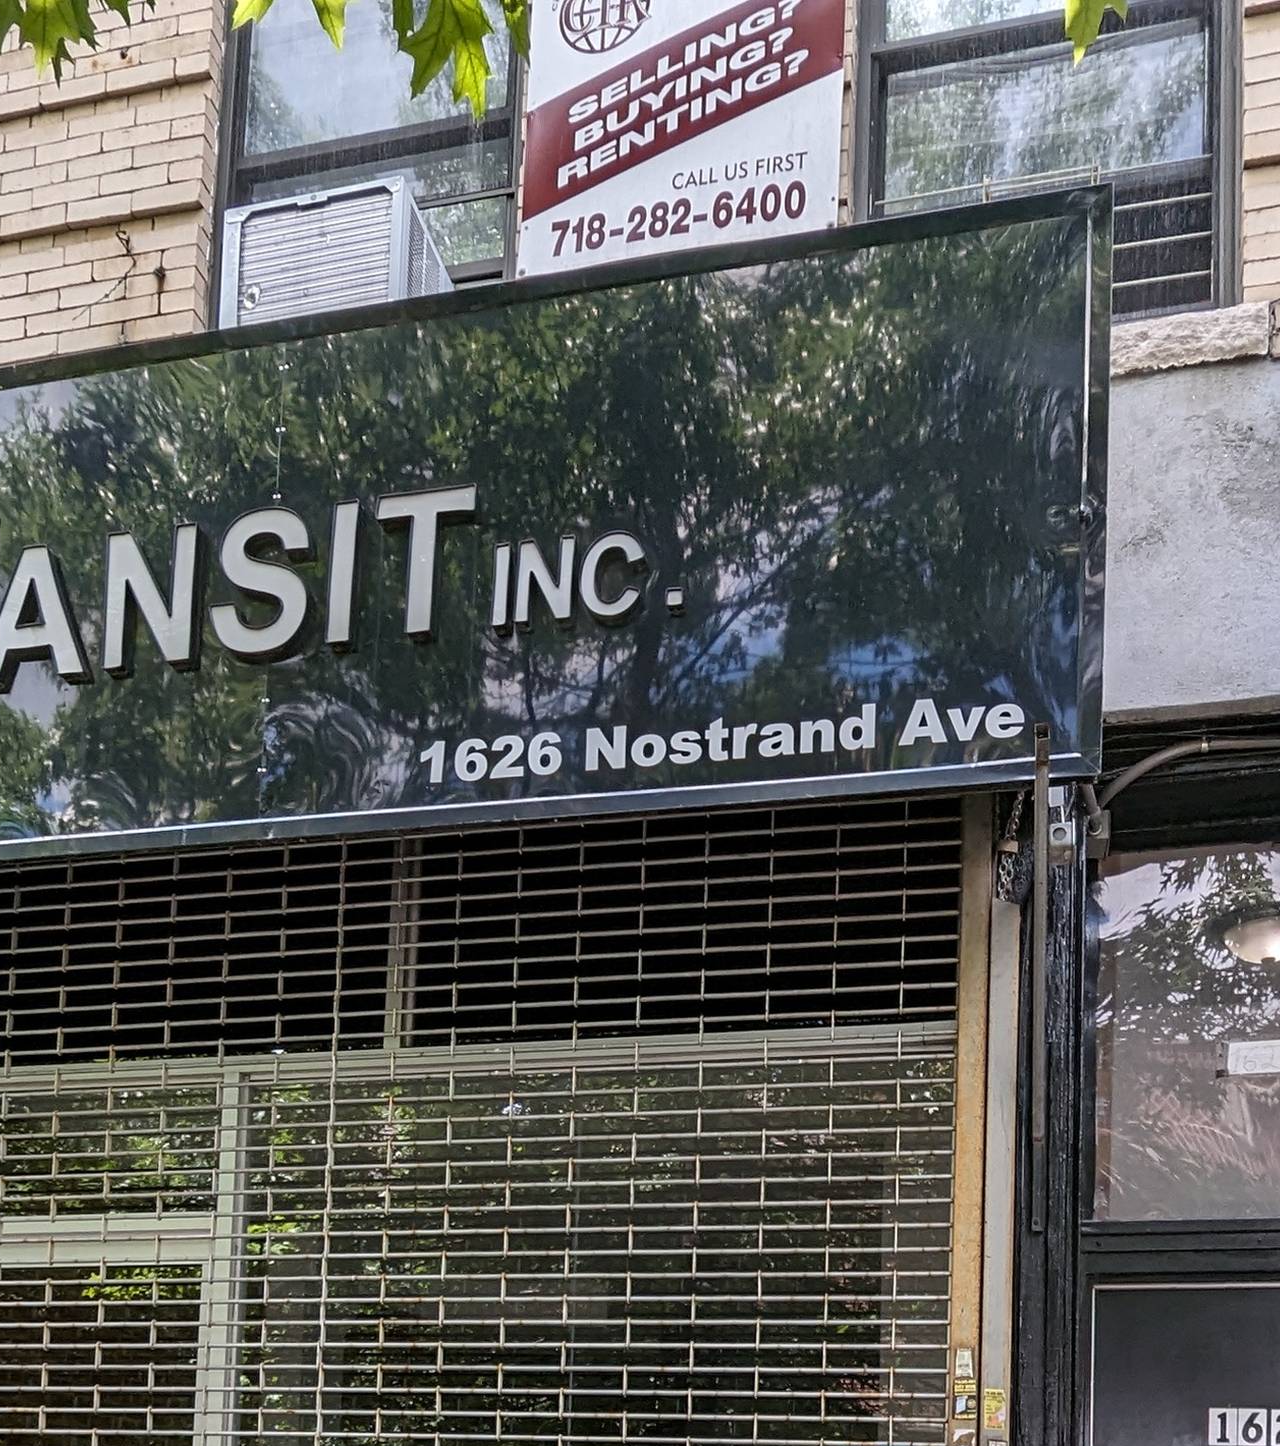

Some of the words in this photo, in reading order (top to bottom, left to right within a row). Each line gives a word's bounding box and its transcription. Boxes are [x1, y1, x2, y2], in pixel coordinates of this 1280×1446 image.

[568, 0, 802, 125] SELLING?
[573, 27, 794, 152] BUYING?
[556, 48, 810, 190] RENTING?
[671, 172, 719, 191] CALL
[724, 161, 749, 182] US
[755, 152, 808, 176] FIRST
[551, 180, 807, 257] 718-282-6400
[491, 530, 686, 636] INC.
[418, 734, 563, 784] 1626
[584, 702, 877, 772] Nostrand
[898, 697, 1026, 747] Ave
